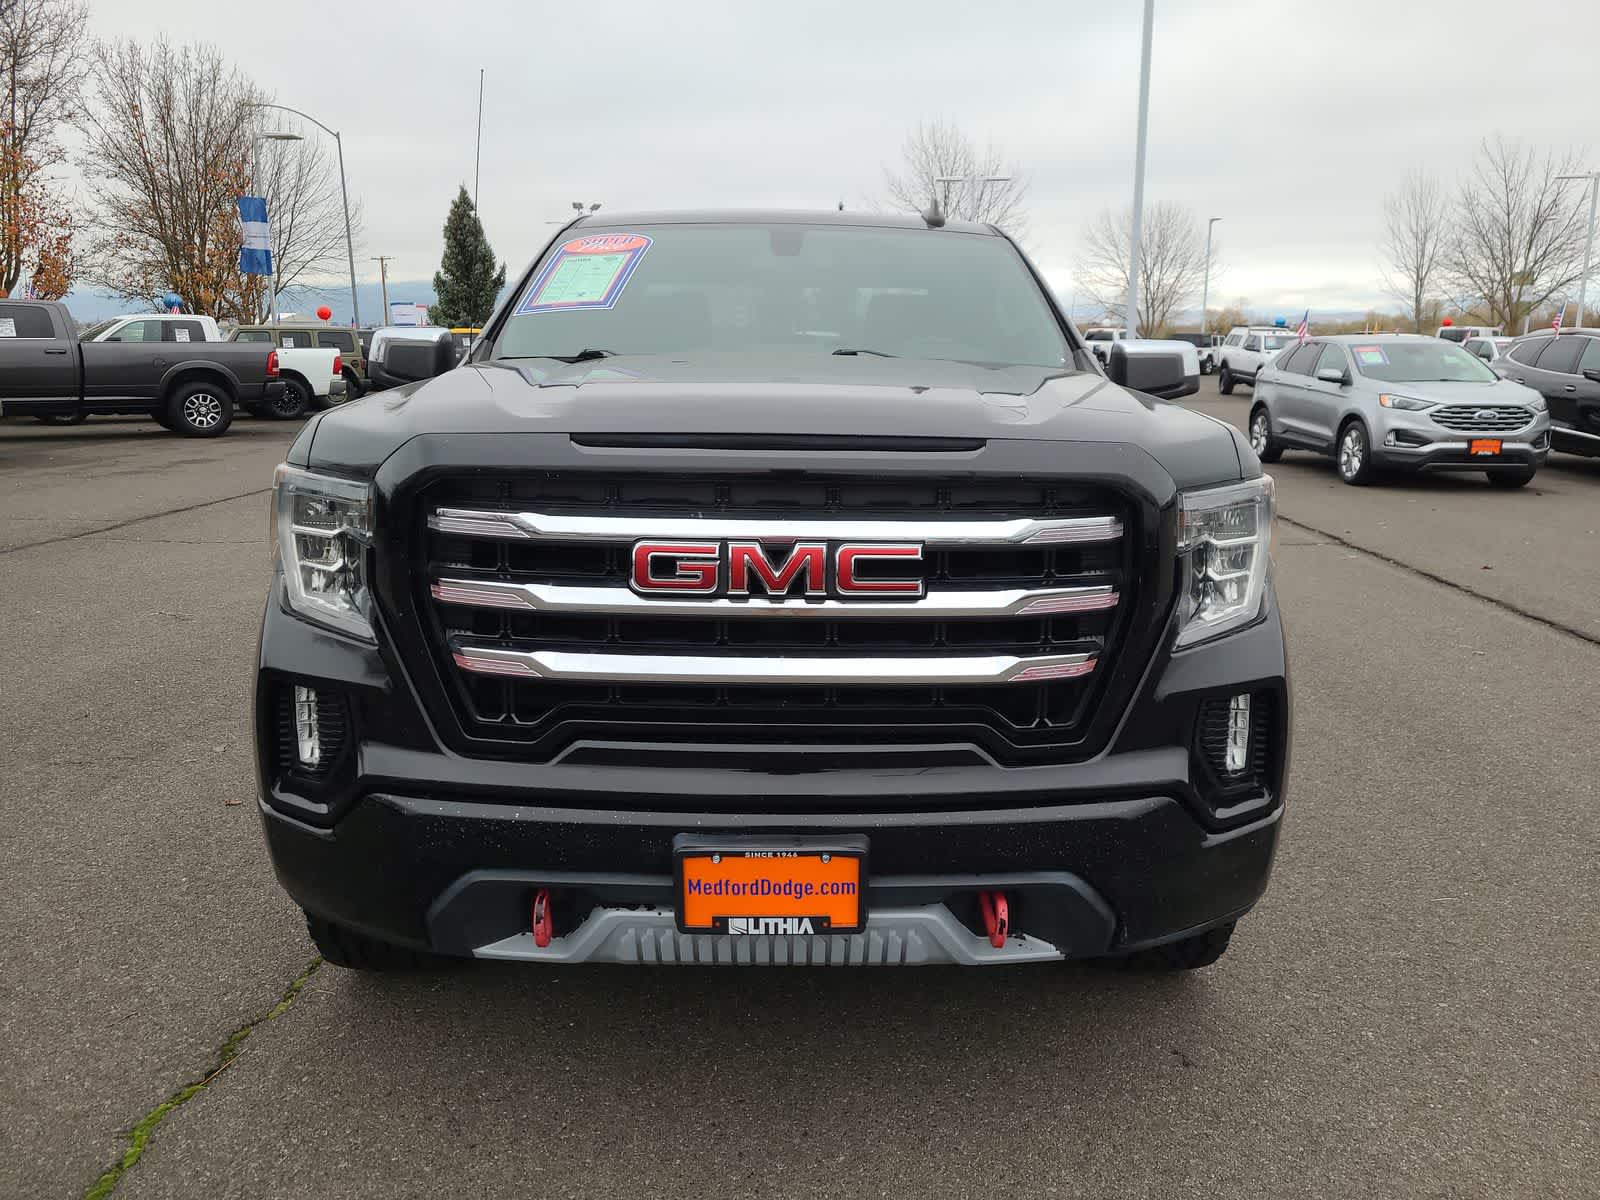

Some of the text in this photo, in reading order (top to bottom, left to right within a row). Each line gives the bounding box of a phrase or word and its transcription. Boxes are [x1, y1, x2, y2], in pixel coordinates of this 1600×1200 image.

[631, 540, 924, 597] GMC
[687, 879, 857, 900] MedfordDodge.com
[748, 917, 815, 935] LITHIA
